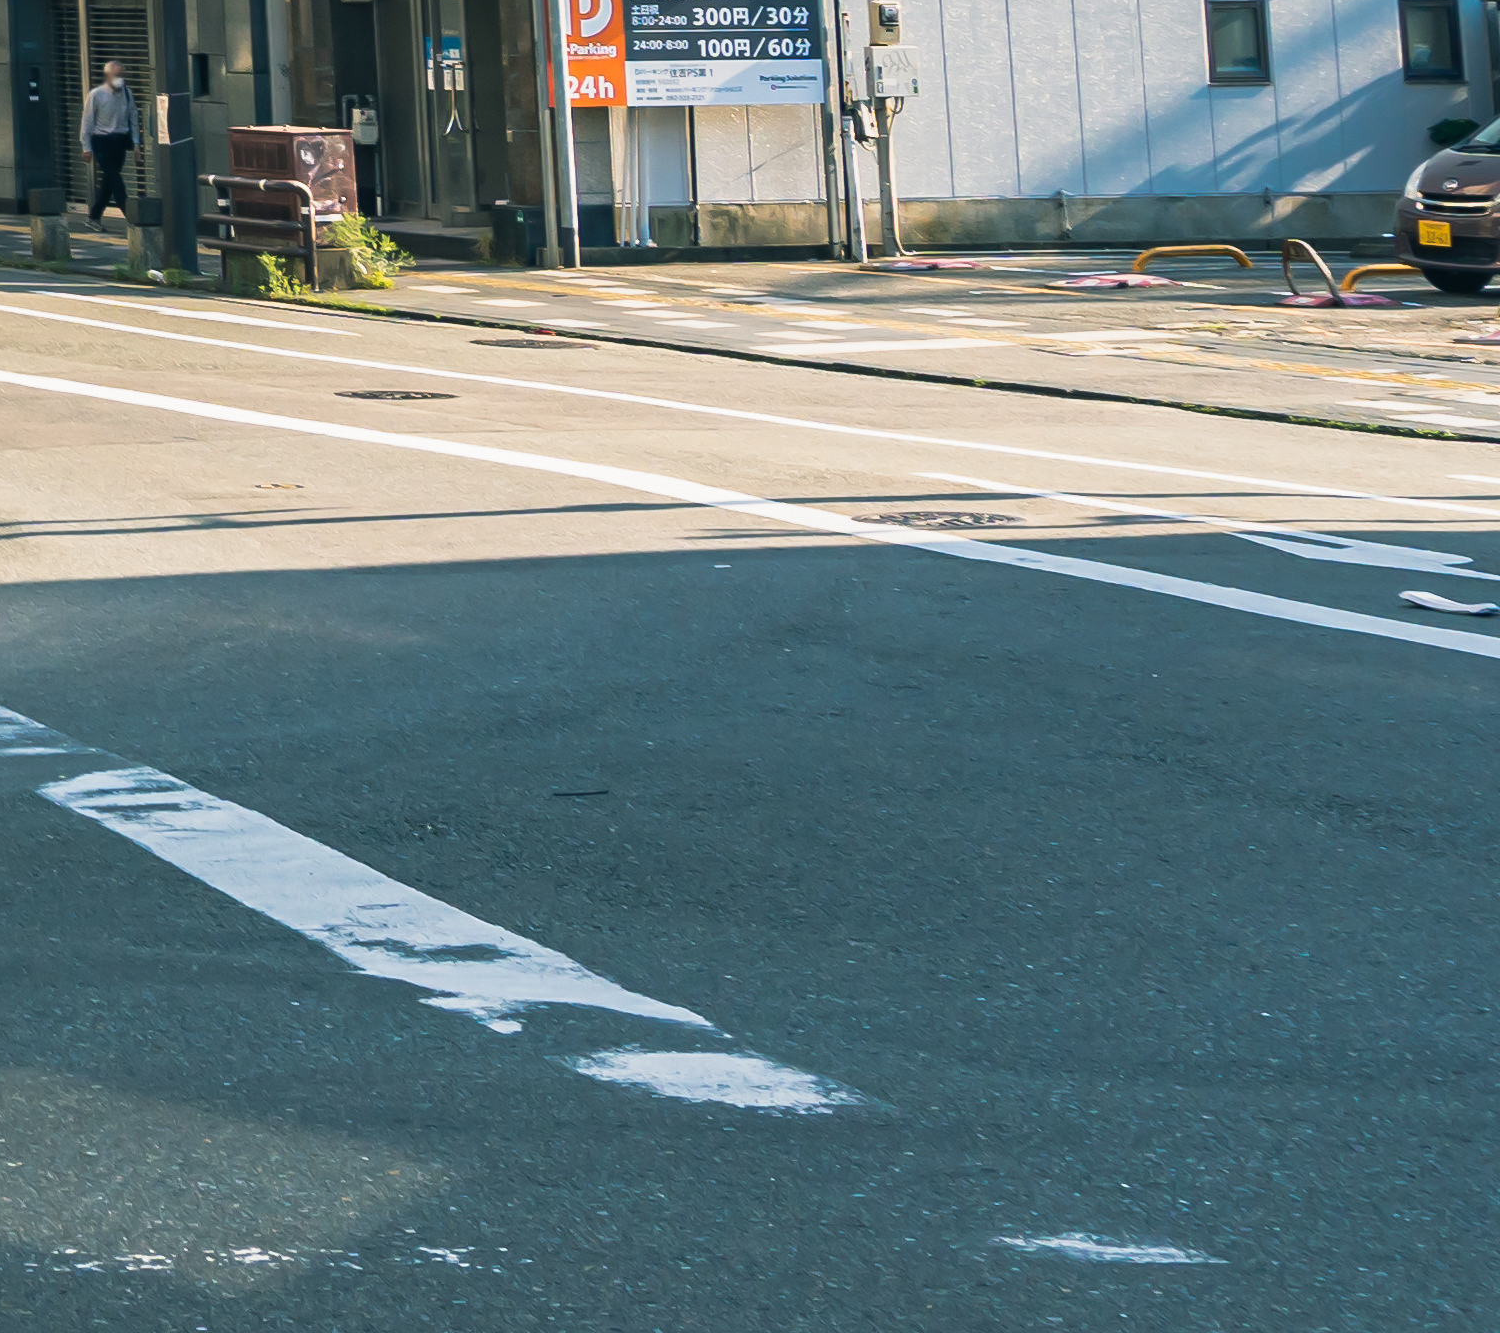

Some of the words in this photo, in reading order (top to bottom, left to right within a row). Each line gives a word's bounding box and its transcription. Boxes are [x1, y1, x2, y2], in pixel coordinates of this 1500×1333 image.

[632, 15, 688, 26] 8:00-24:00
[633, 40, 689, 51] 24:00-8:00
[567, 76, 615, 100] 24h
